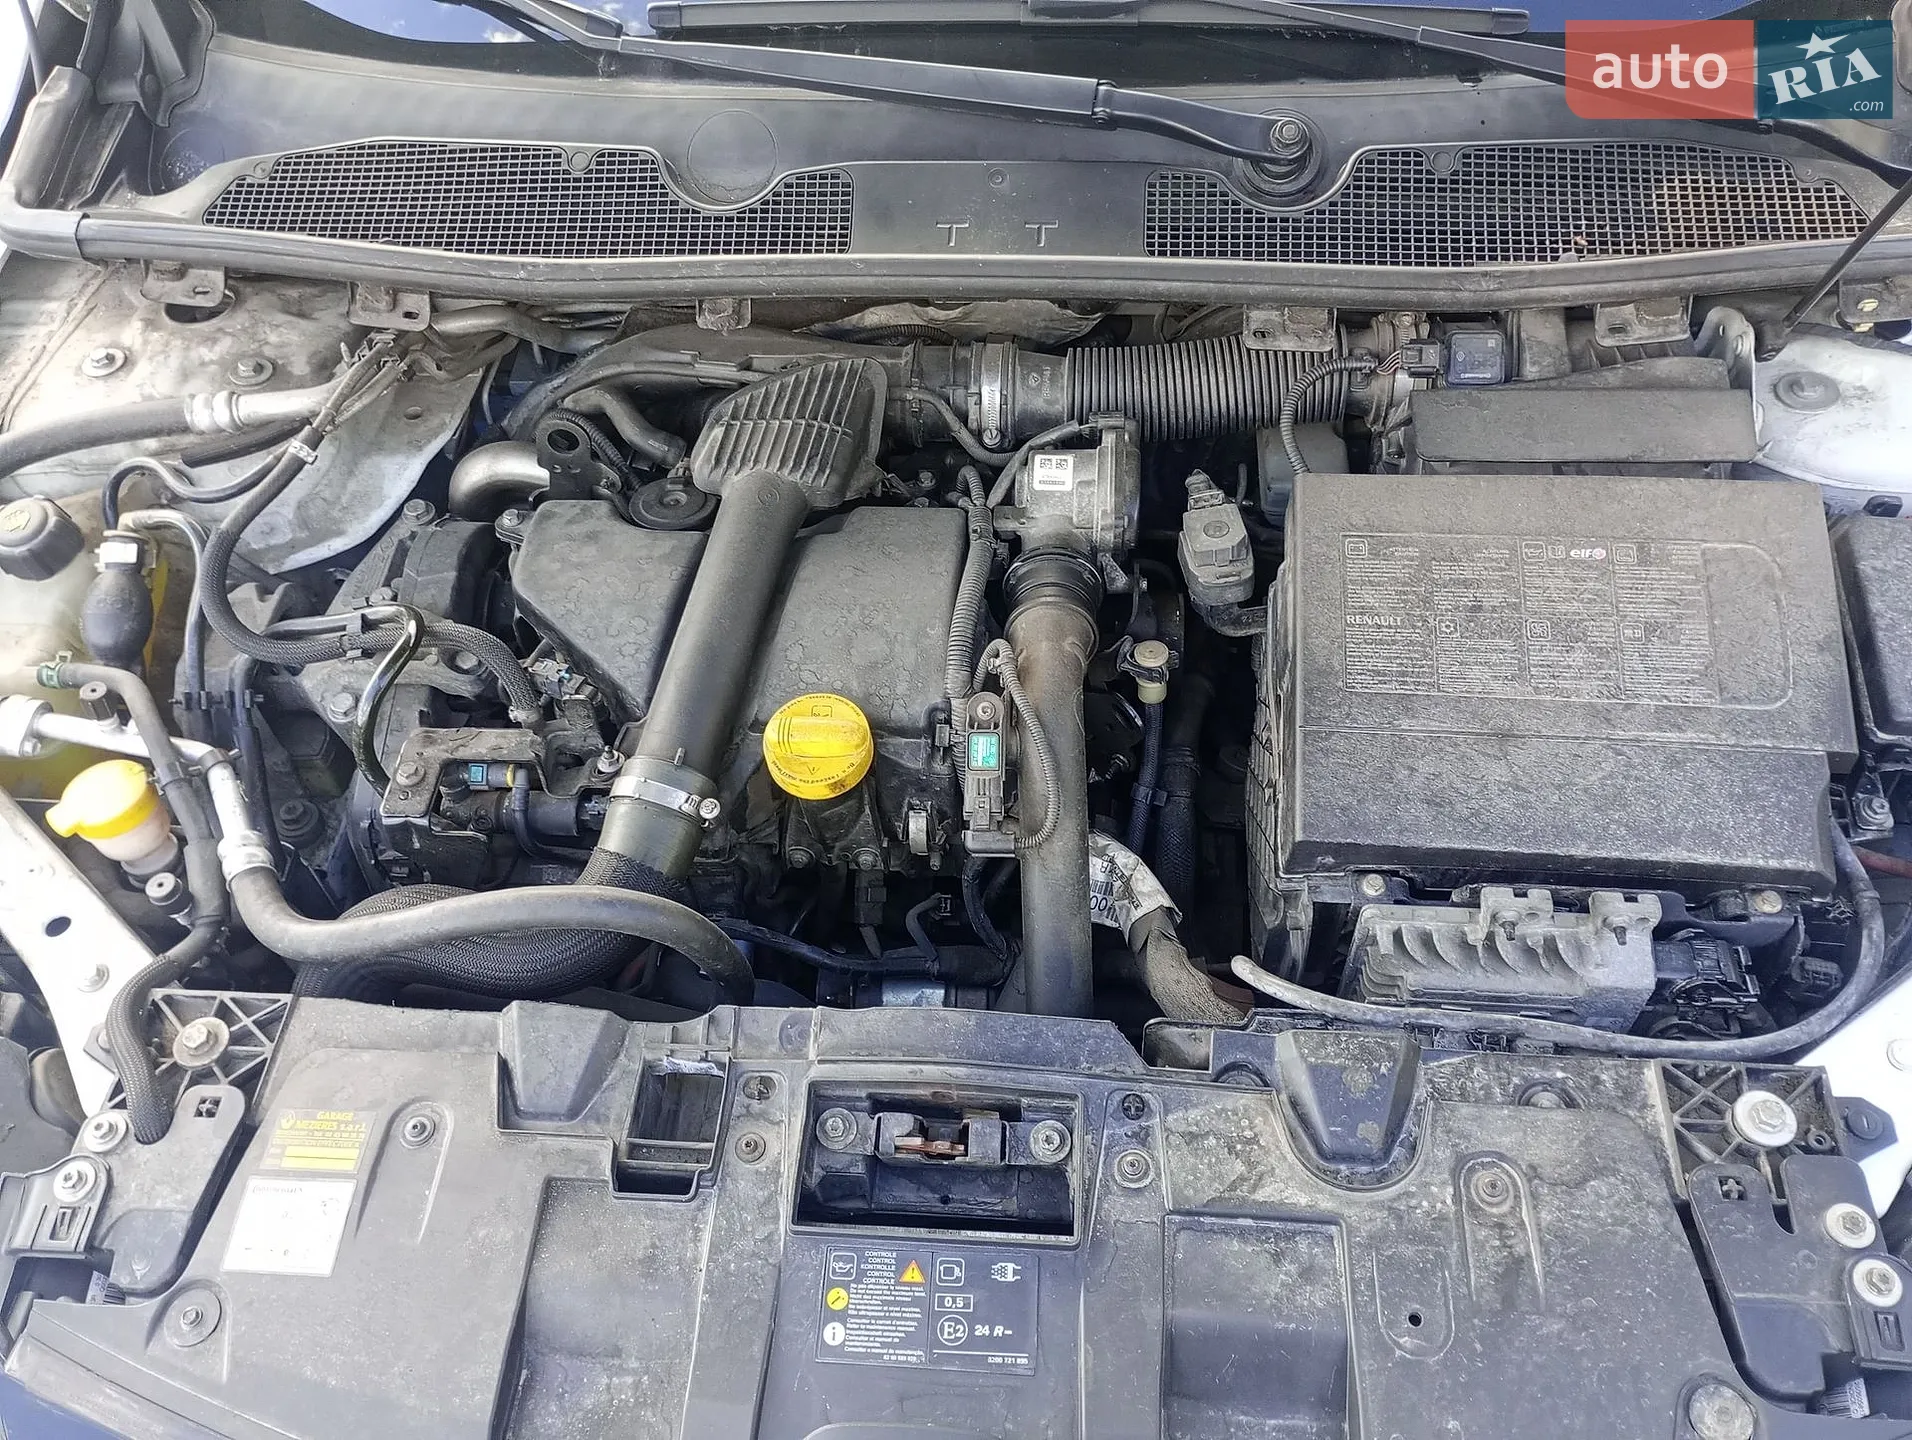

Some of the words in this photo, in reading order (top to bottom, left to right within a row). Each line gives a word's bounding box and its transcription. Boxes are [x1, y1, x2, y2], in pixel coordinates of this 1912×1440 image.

[1346, 615, 1400, 626] RENAULT
[944, 1297, 964, 1308] 0,5
[942, 1322, 964, 1339] E2
[974, 1325, 990, 1336] 24
